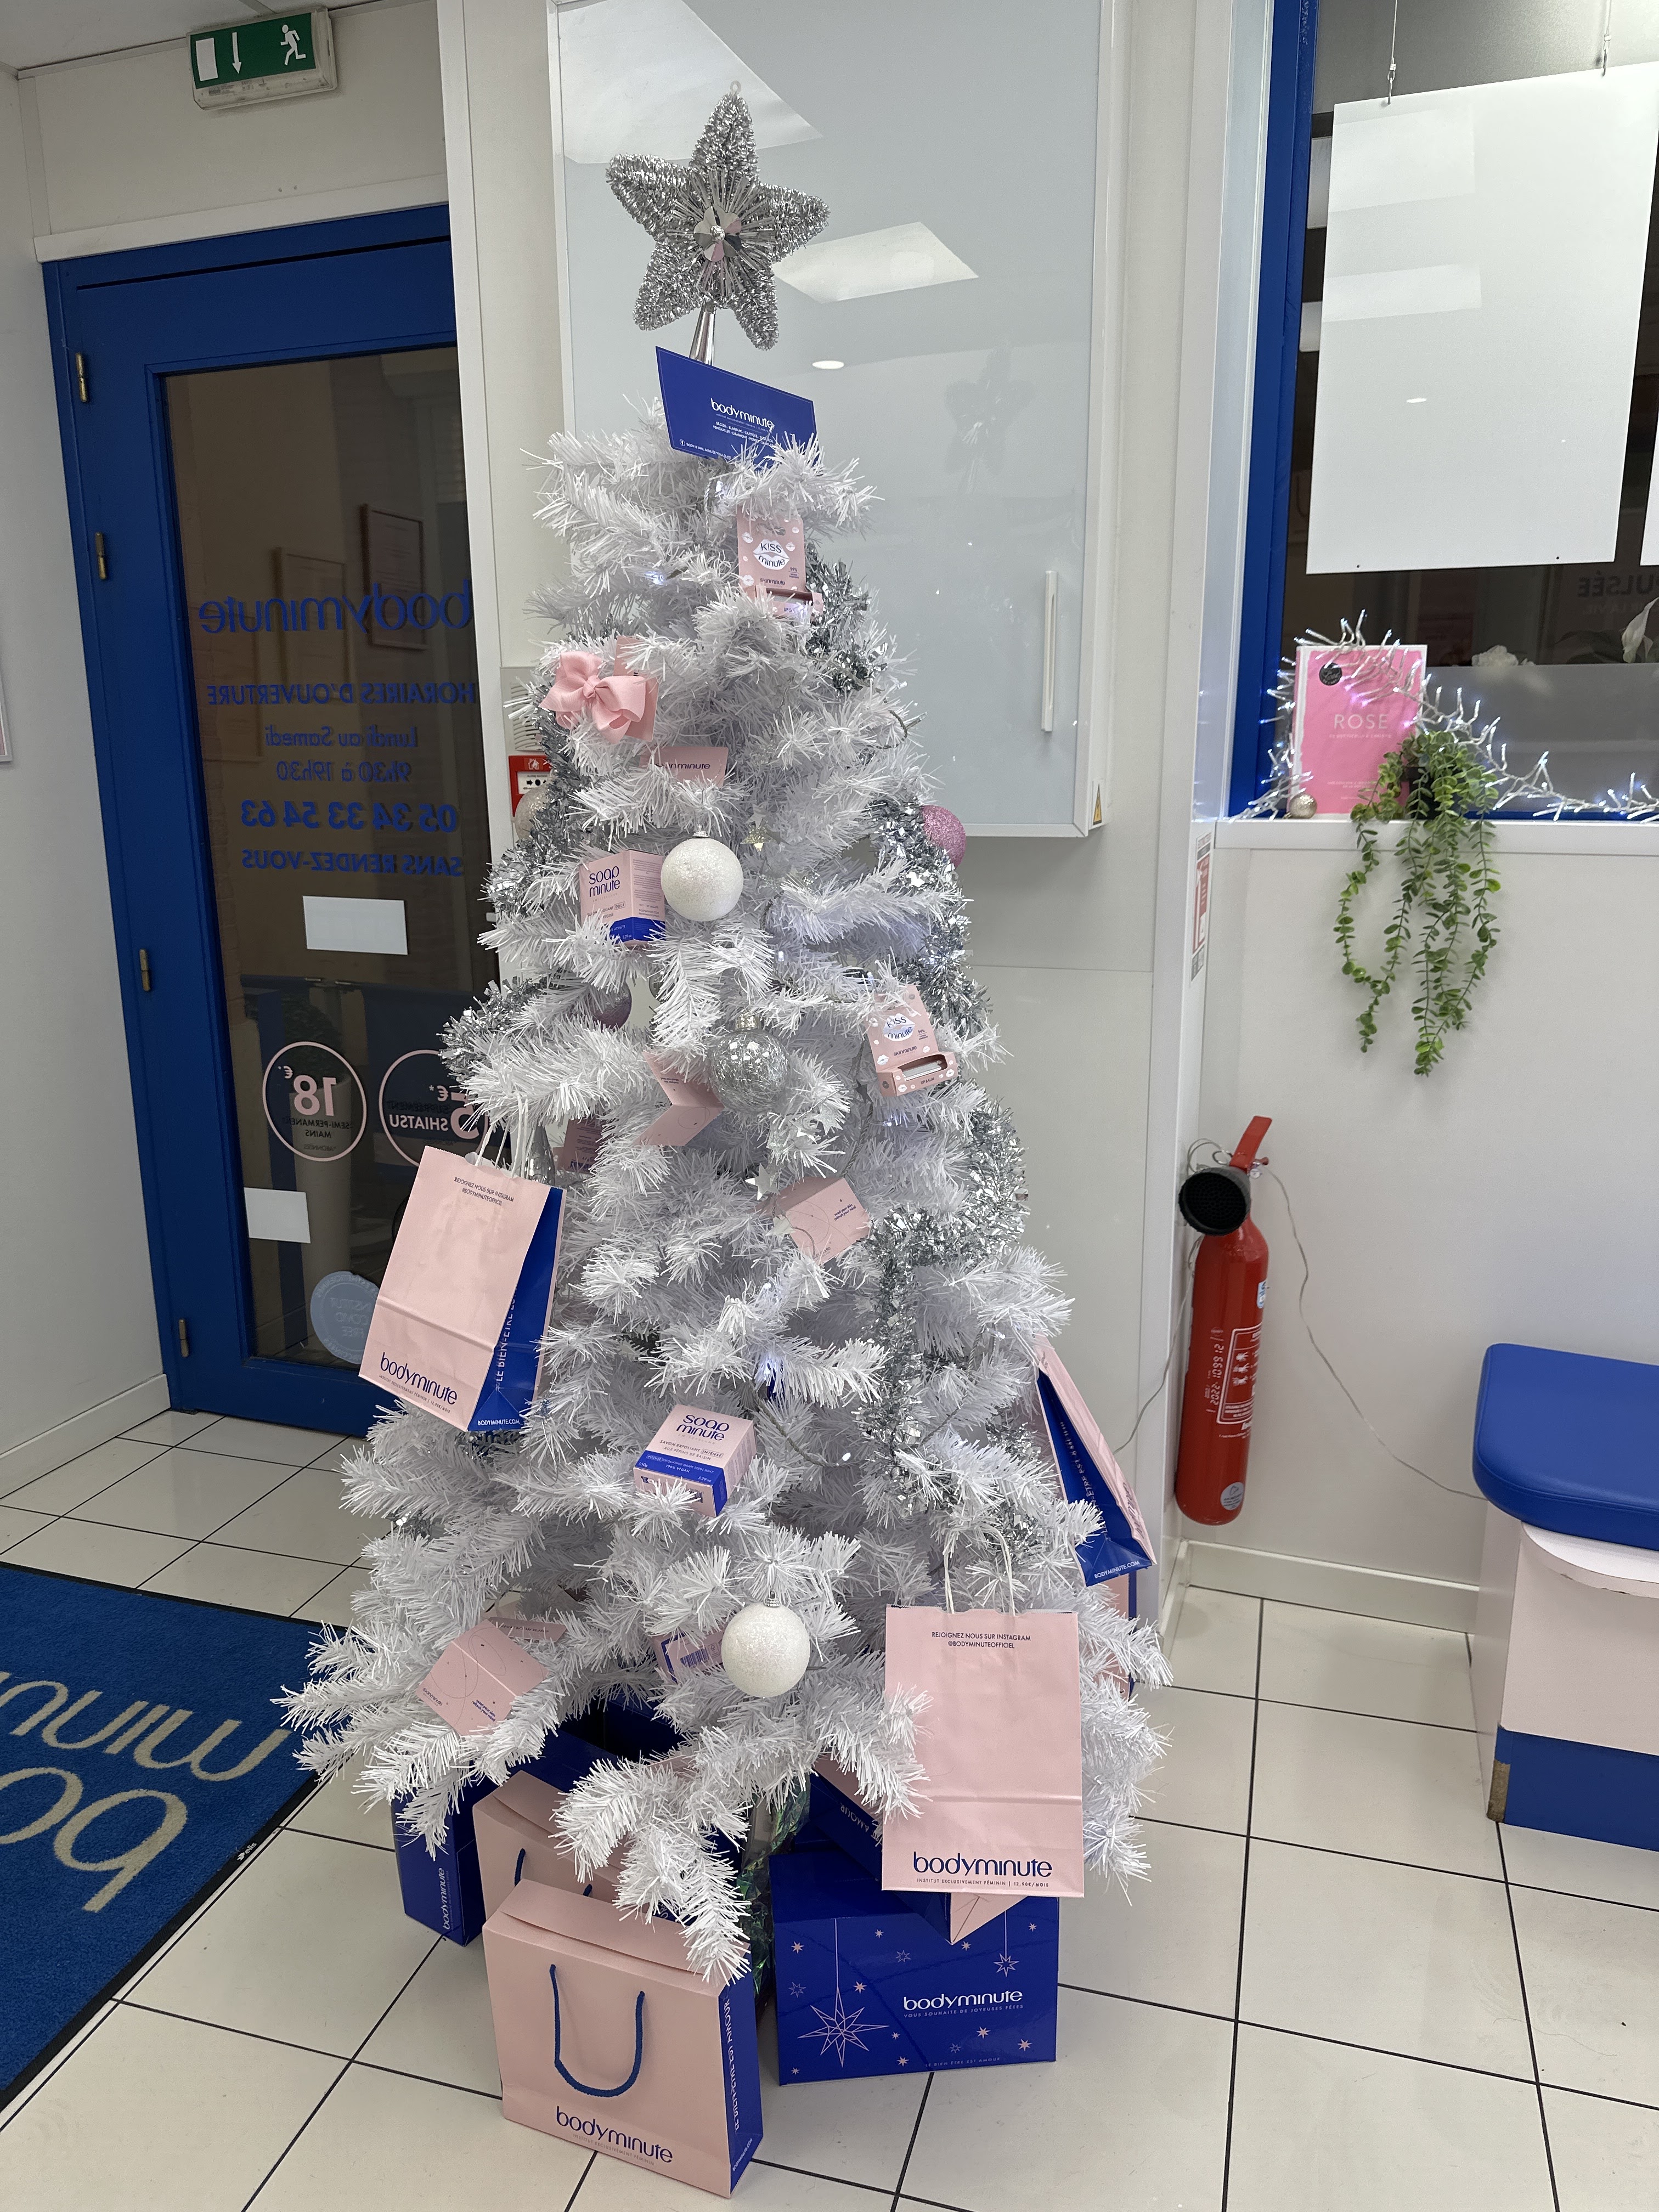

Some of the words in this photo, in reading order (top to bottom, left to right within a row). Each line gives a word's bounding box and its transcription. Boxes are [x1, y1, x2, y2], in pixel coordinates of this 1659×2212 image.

[711, 398, 774, 428] bodyminute
[760, 543, 782, 553] KISS
[758, 555, 785, 567] minute
[1334, 714, 1389, 730] ROSE
[589, 866, 619, 884] soap
[590, 879, 620, 897] minute
[887, 1017, 906, 1028] KISS
[888, 1026, 913, 1039] minute
[454, 1177, 475, 1188] REJOIGNEZ
[475, 1184, 486, 1192] NOUS
[380, 1352, 458, 1405] bodyminute
[676, 1424, 725, 1441] minute
[683, 1415, 730, 1432] soap
[676, 1443, 701, 1452] EXFOLIANT
[1094, 1560, 1140, 1579] BODYMINUTE.COM
[948, 1640, 1015, 1649] @BODYMINUTEOFFICIEL
[0, 1672, 292, 1782] minu
[840, 1802, 869, 1832] AMOUR
[245, 1842, 257, 1854] elis
[913, 1851, 1053, 1877] bodyminute
[439, 1867, 450, 1930] bodyminute
[904, 1990, 1023, 2011] bodyminute
[724, 1998, 732, 2043] AMOUR
[556, 2106, 673, 2163] bodyminute
